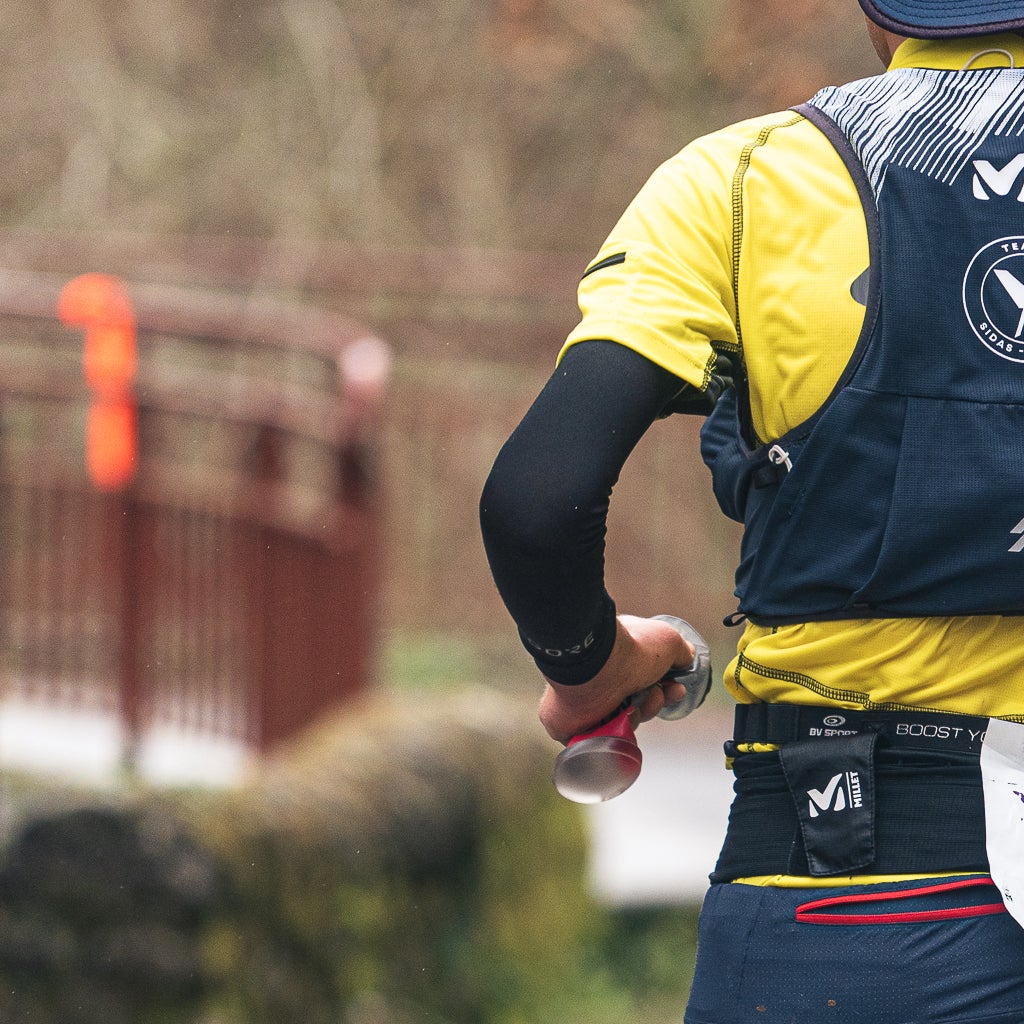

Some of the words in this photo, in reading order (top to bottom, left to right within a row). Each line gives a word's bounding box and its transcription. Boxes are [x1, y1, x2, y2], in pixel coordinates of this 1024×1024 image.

[980, 322, 1013, 353] SIDAS
[809, 728, 823, 736] BV
[896, 724, 963, 739] BOOST
[850, 771, 862, 808] MILLET
